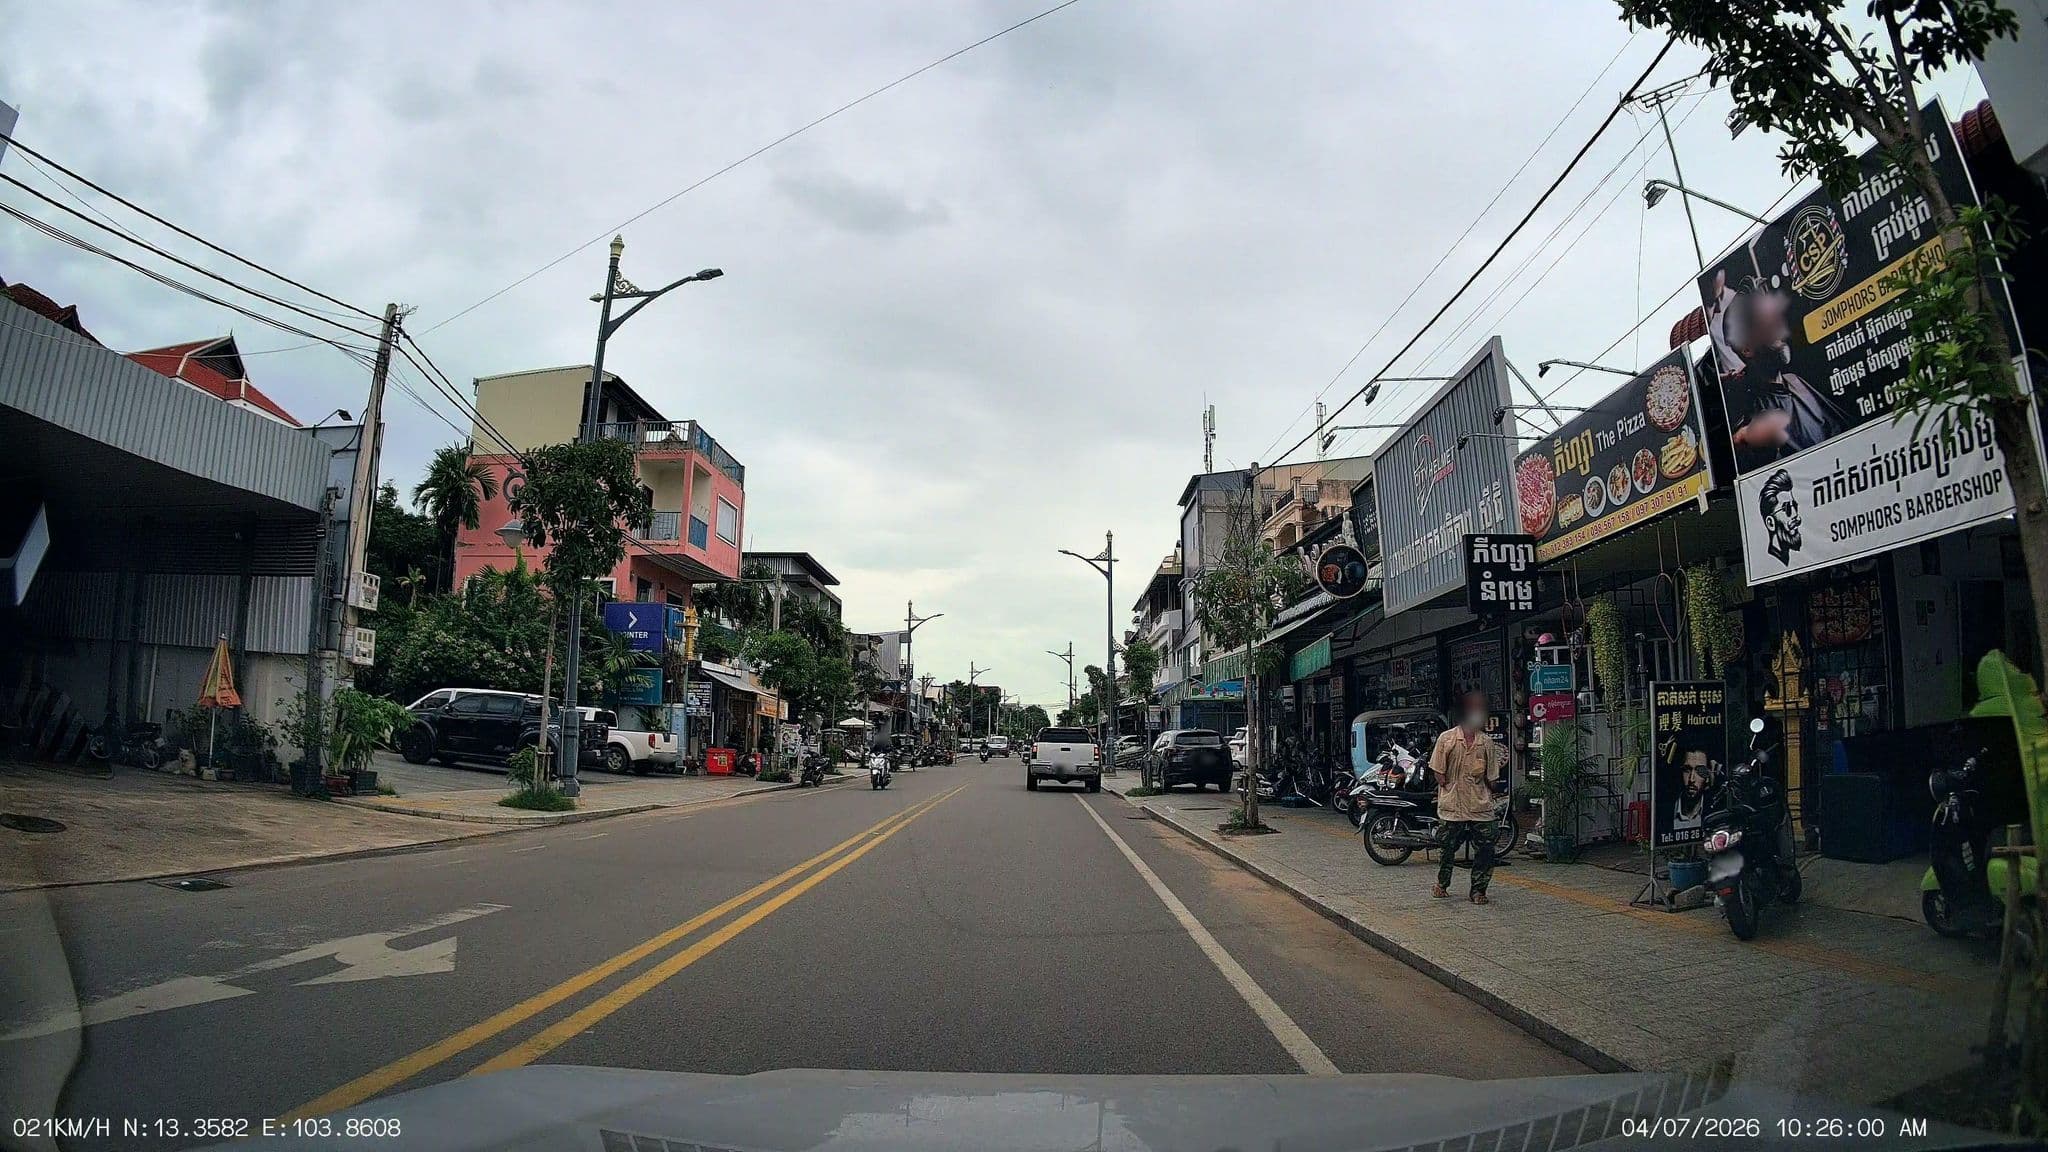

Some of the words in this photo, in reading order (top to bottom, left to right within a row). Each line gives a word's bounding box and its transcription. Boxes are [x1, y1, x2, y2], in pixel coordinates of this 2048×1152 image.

[1800, 232, 1827, 272] CSP
[1821, 285, 1876, 330] SOMPHORS
[1595, 429, 1616, 452] The
[1616, 411, 1646, 440] Pizza
[1635, 502, 1648, 516] 097
[1651, 495, 1663, 509] 307
[1830, 501, 1902, 543] SOMPHORS
[1907, 468, 2003, 520] BARBERSHOP
[618, 631, 650, 640] INTER
[1675, 830, 1689, 841] 016
